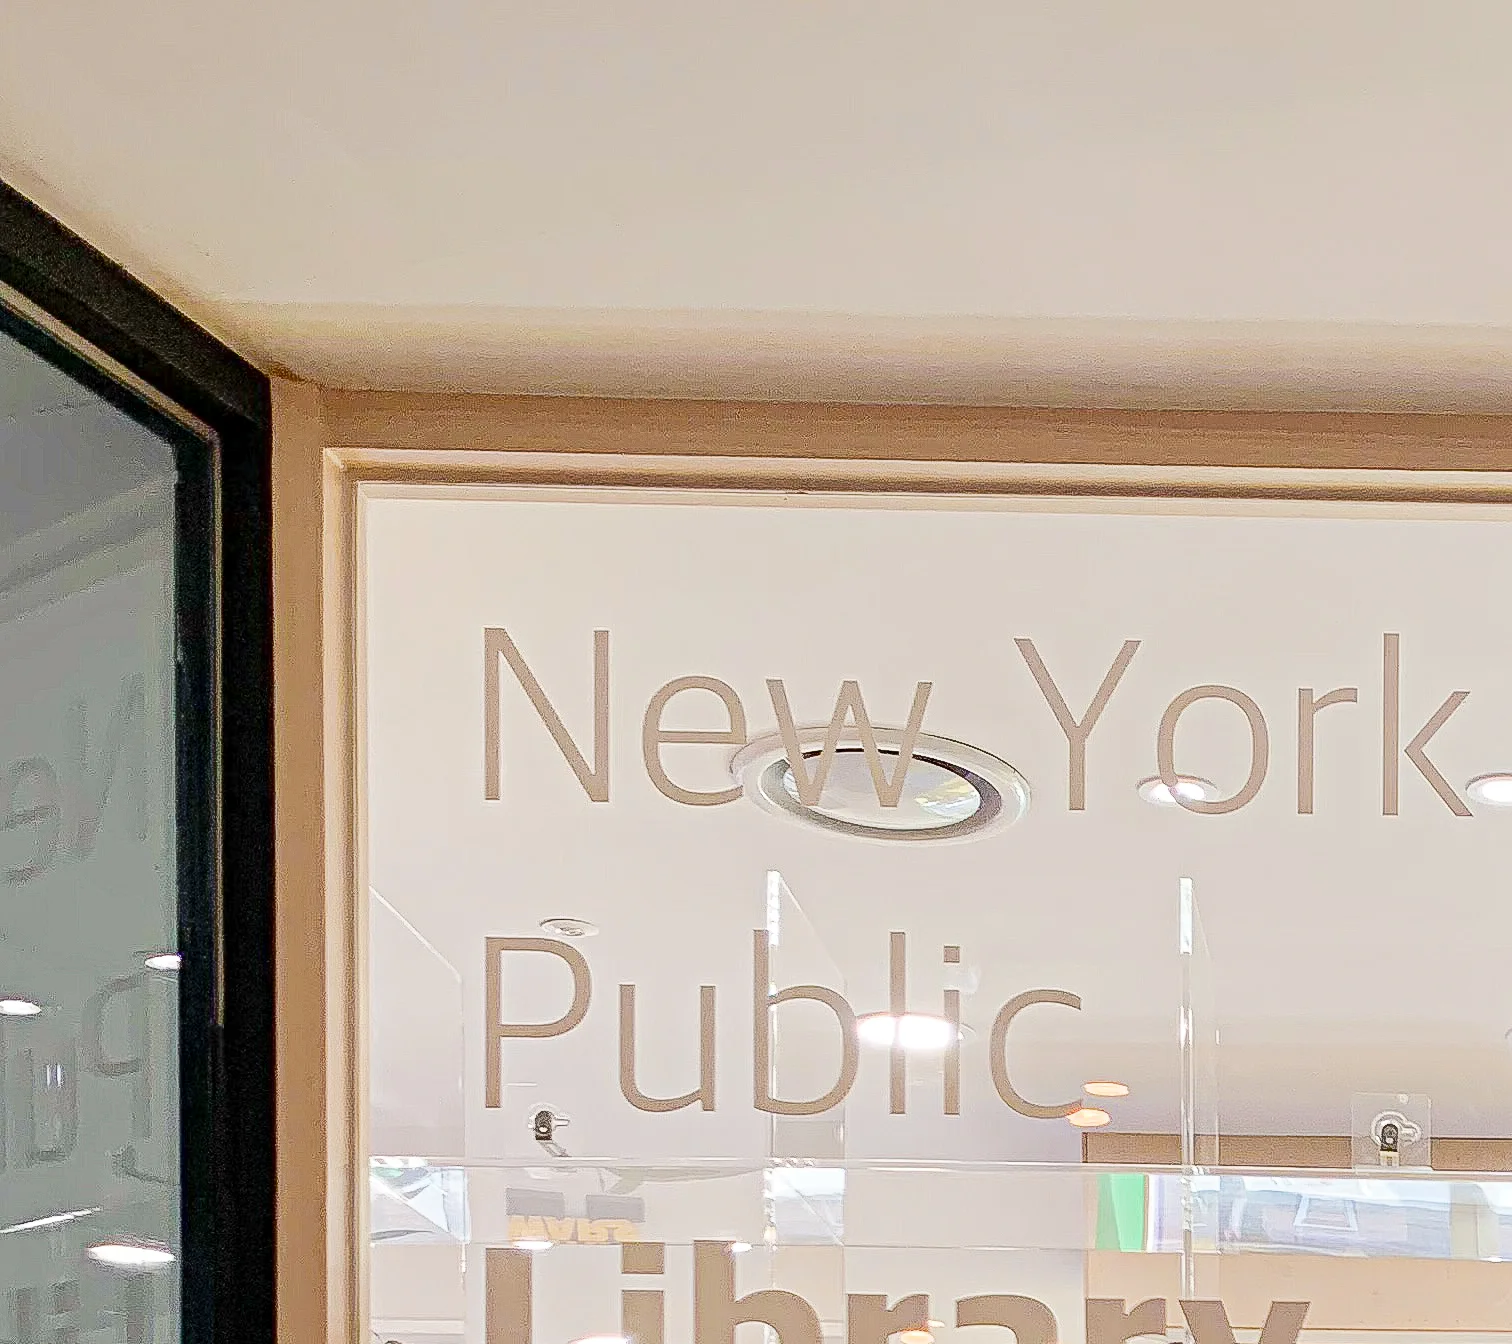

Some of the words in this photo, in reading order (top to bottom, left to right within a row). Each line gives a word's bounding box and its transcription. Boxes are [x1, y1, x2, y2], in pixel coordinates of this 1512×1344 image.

[483, 626, 933, 808] New
[1012, 631, 1474, 818] York
[484, 929, 1085, 1119] Public
